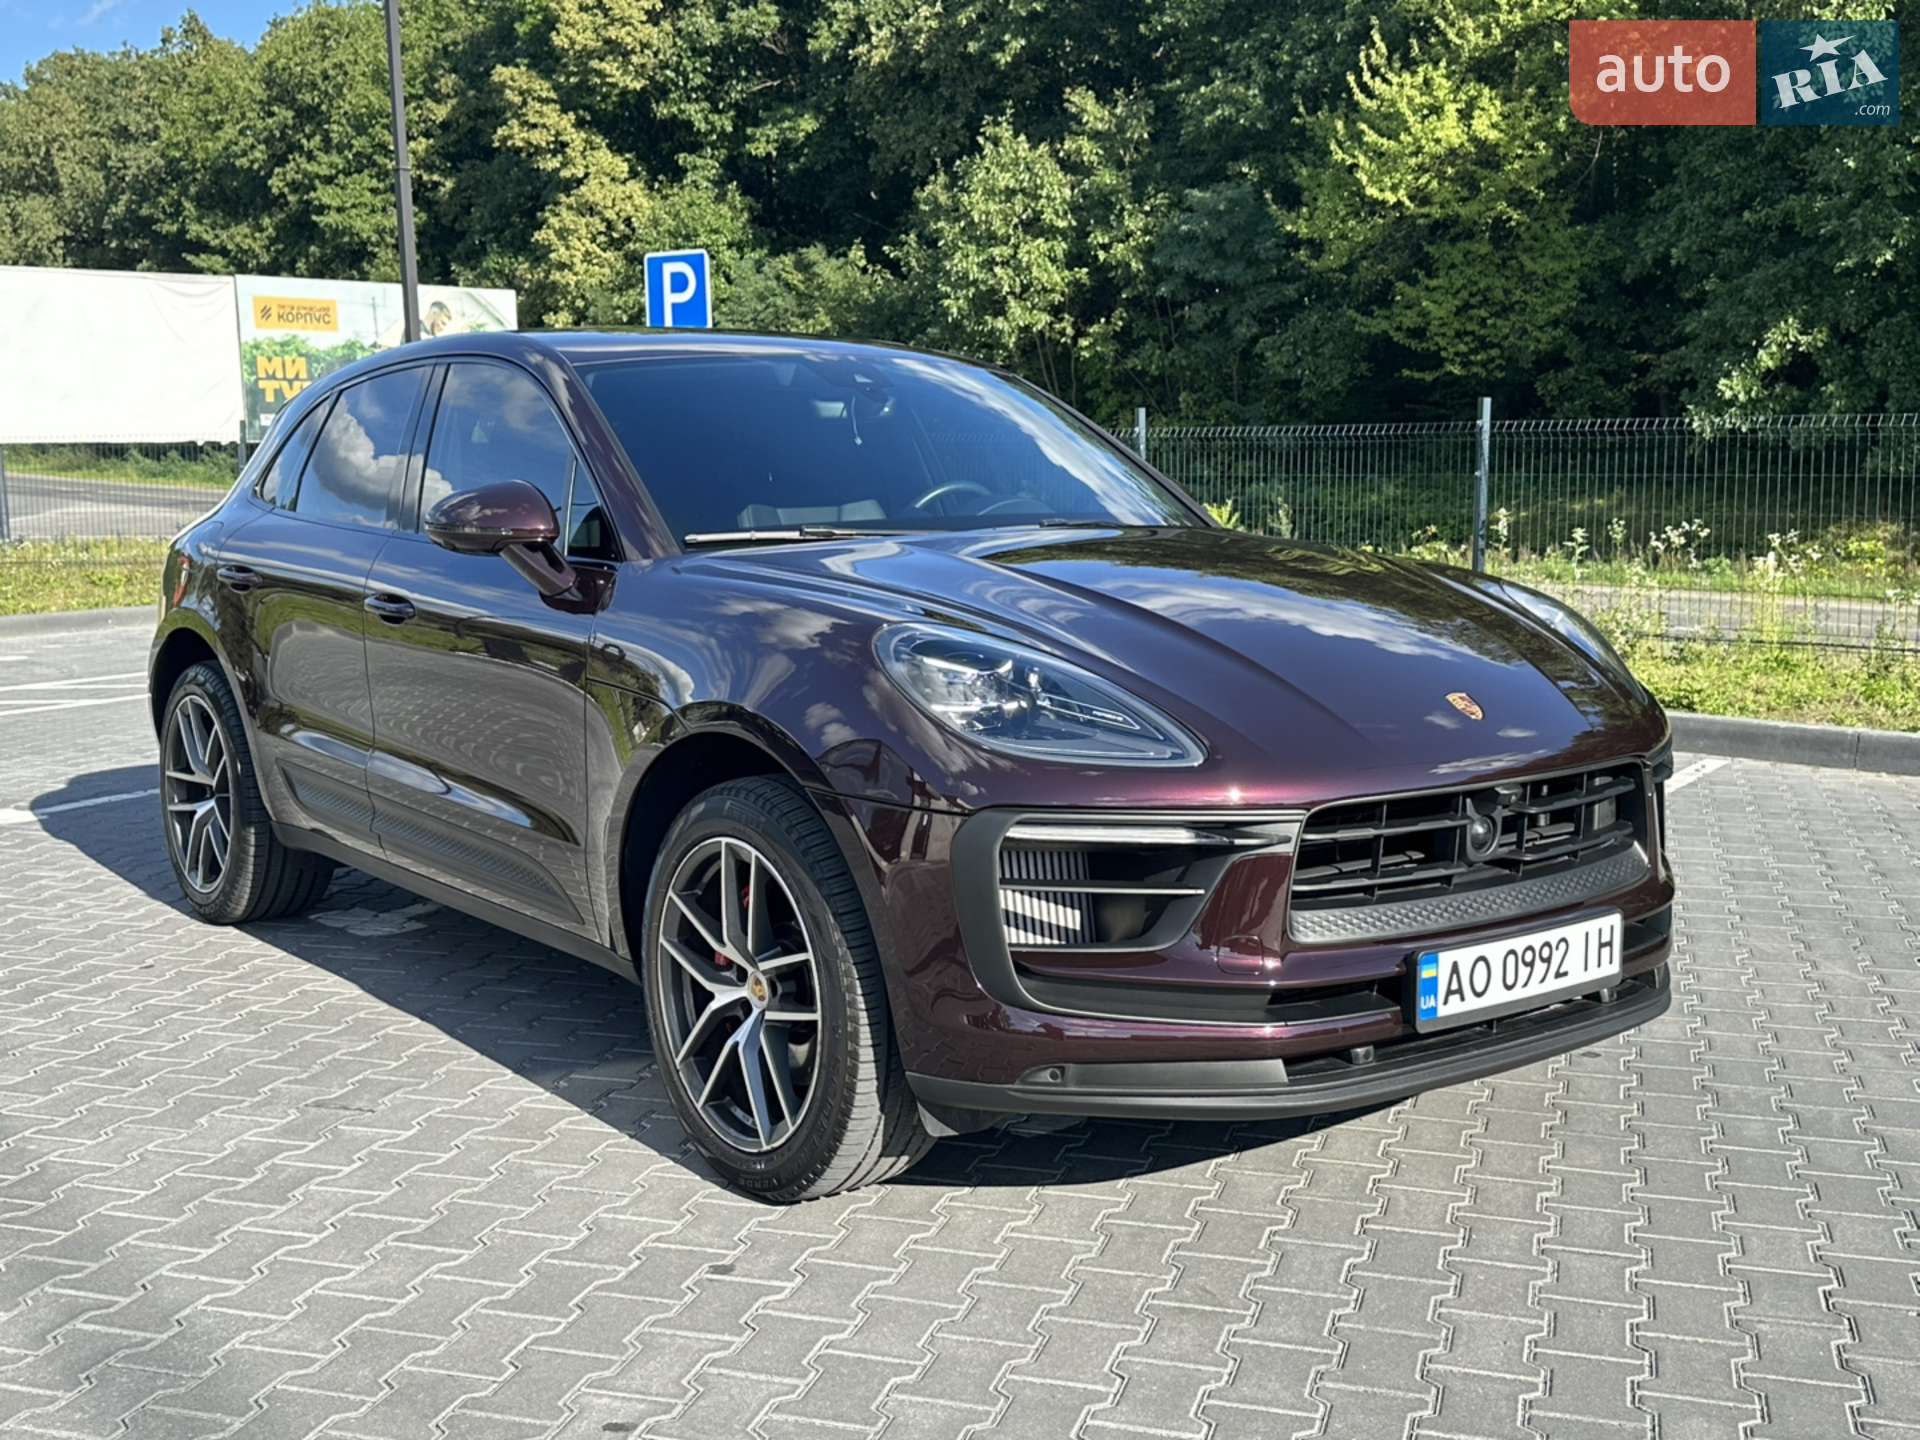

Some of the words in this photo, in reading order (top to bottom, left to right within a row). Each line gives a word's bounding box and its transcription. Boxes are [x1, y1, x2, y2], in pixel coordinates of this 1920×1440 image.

[662, 261, 696, 327] P
[277, 311, 331, 325] КОРПУС
[257, 355, 308, 380] МИ
[258, 380, 312, 403] ТУ
[1443, 955, 1492, 1006] AO
[1502, 937, 1569, 991] 0992
[1583, 924, 1614, 972] IH
[1421, 994, 1436, 1010] UA
